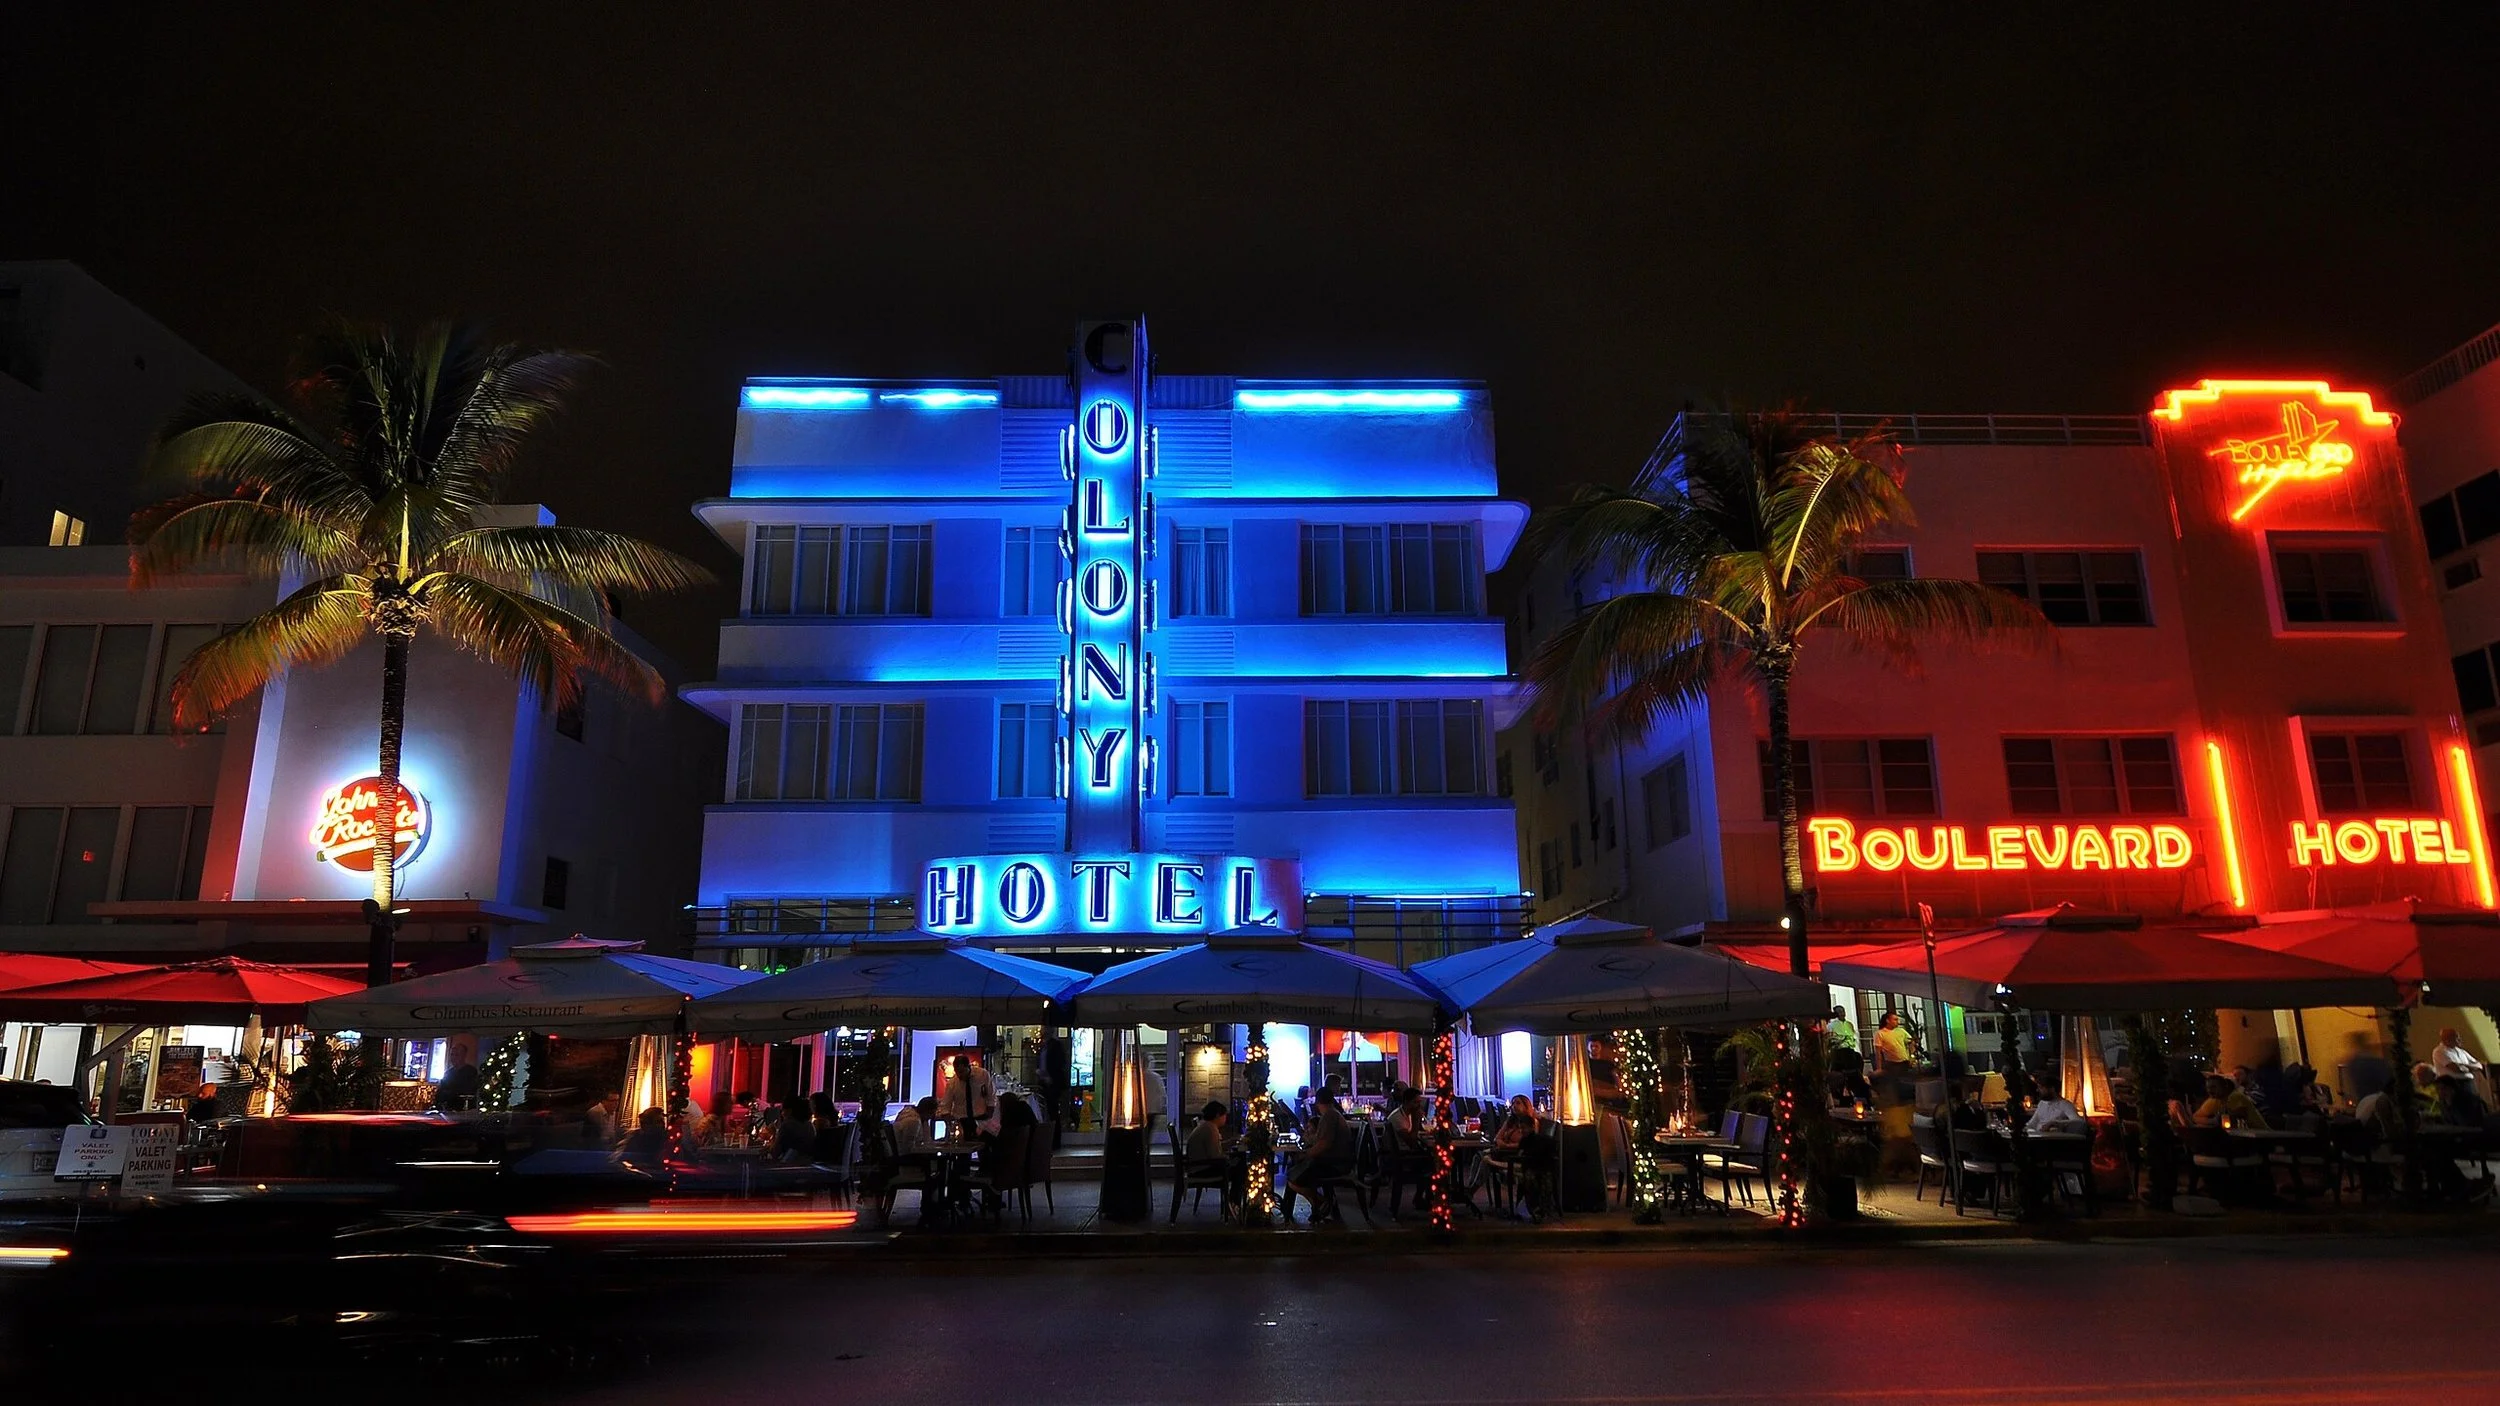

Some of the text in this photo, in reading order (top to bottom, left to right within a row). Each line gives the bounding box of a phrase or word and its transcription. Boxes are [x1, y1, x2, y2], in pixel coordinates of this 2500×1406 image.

[1079, 322, 1130, 787] COLONY
[1808, 817, 2194, 872] BOULEVARD
[2289, 818, 2472, 866] HOTEL
[926, 861, 1278, 927] HOTEL
[410, 1004, 584, 1021] Columbus Restaurant
[782, 1003, 947, 1021] Columbus Restaurant
[1173, 1000, 1336, 1017] Columbus Restaurant
[1567, 1001, 1732, 1023] Columbus Restaurant
[136, 1146, 166, 1157] VALET
[128, 1160, 171, 1170] PARKING
